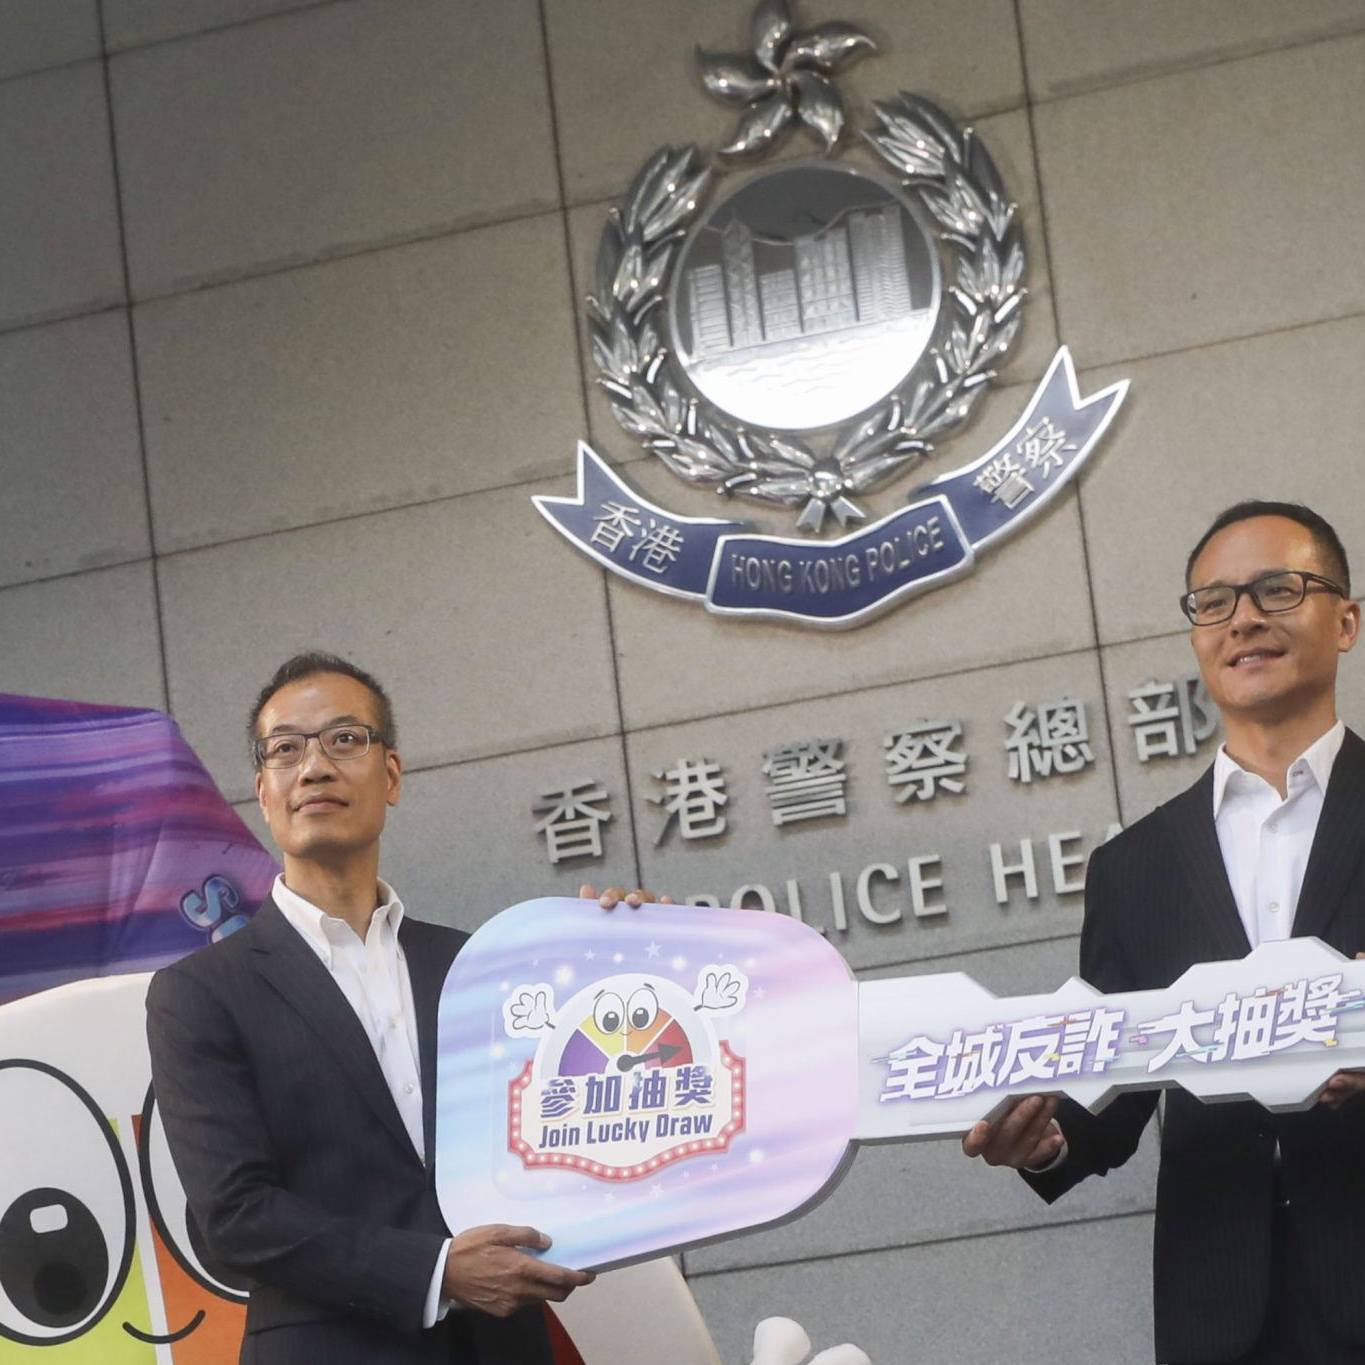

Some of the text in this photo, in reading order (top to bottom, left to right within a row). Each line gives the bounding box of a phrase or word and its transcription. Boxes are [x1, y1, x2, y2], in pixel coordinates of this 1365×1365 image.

[973, 416, 1077, 511] 警察
[590, 500, 684, 574] 香港
[731, 515, 944, 593] HONG KONG POLICE
[532, 673, 1219, 864] 香港警察總部
[880, 973, 1364, 1102] 全城反詐 大抽獎
[540, 1065, 712, 1118] 參加抽獎
[539, 1114, 713, 1149] Join Lucky Draw
